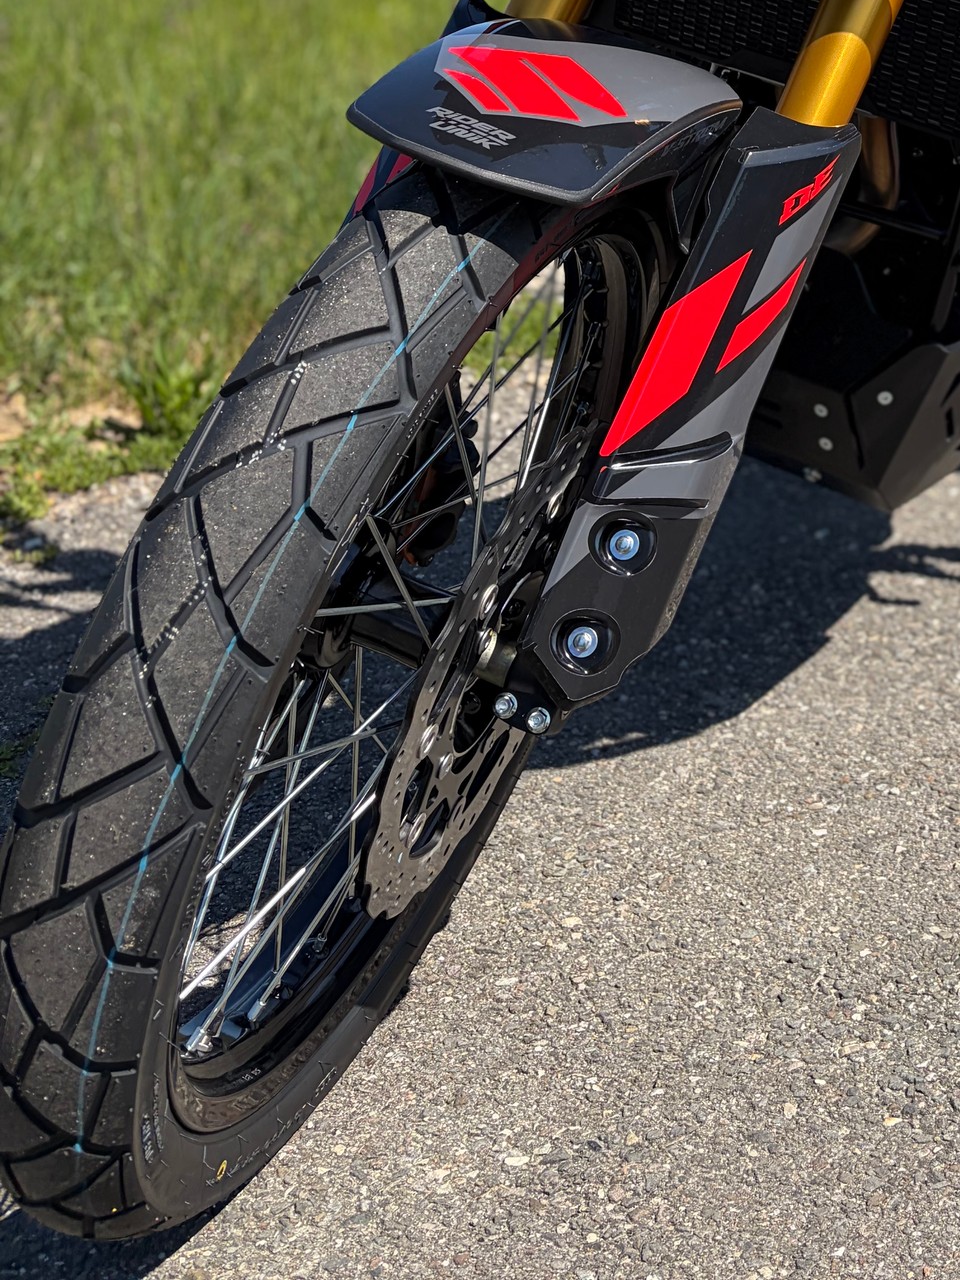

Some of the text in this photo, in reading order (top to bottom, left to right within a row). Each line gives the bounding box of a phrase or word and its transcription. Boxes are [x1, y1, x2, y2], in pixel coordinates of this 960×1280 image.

[425, 106, 517, 141] RIDER
[429, 120, 509, 150] UNIK
[778, 153, 841, 226] DE
